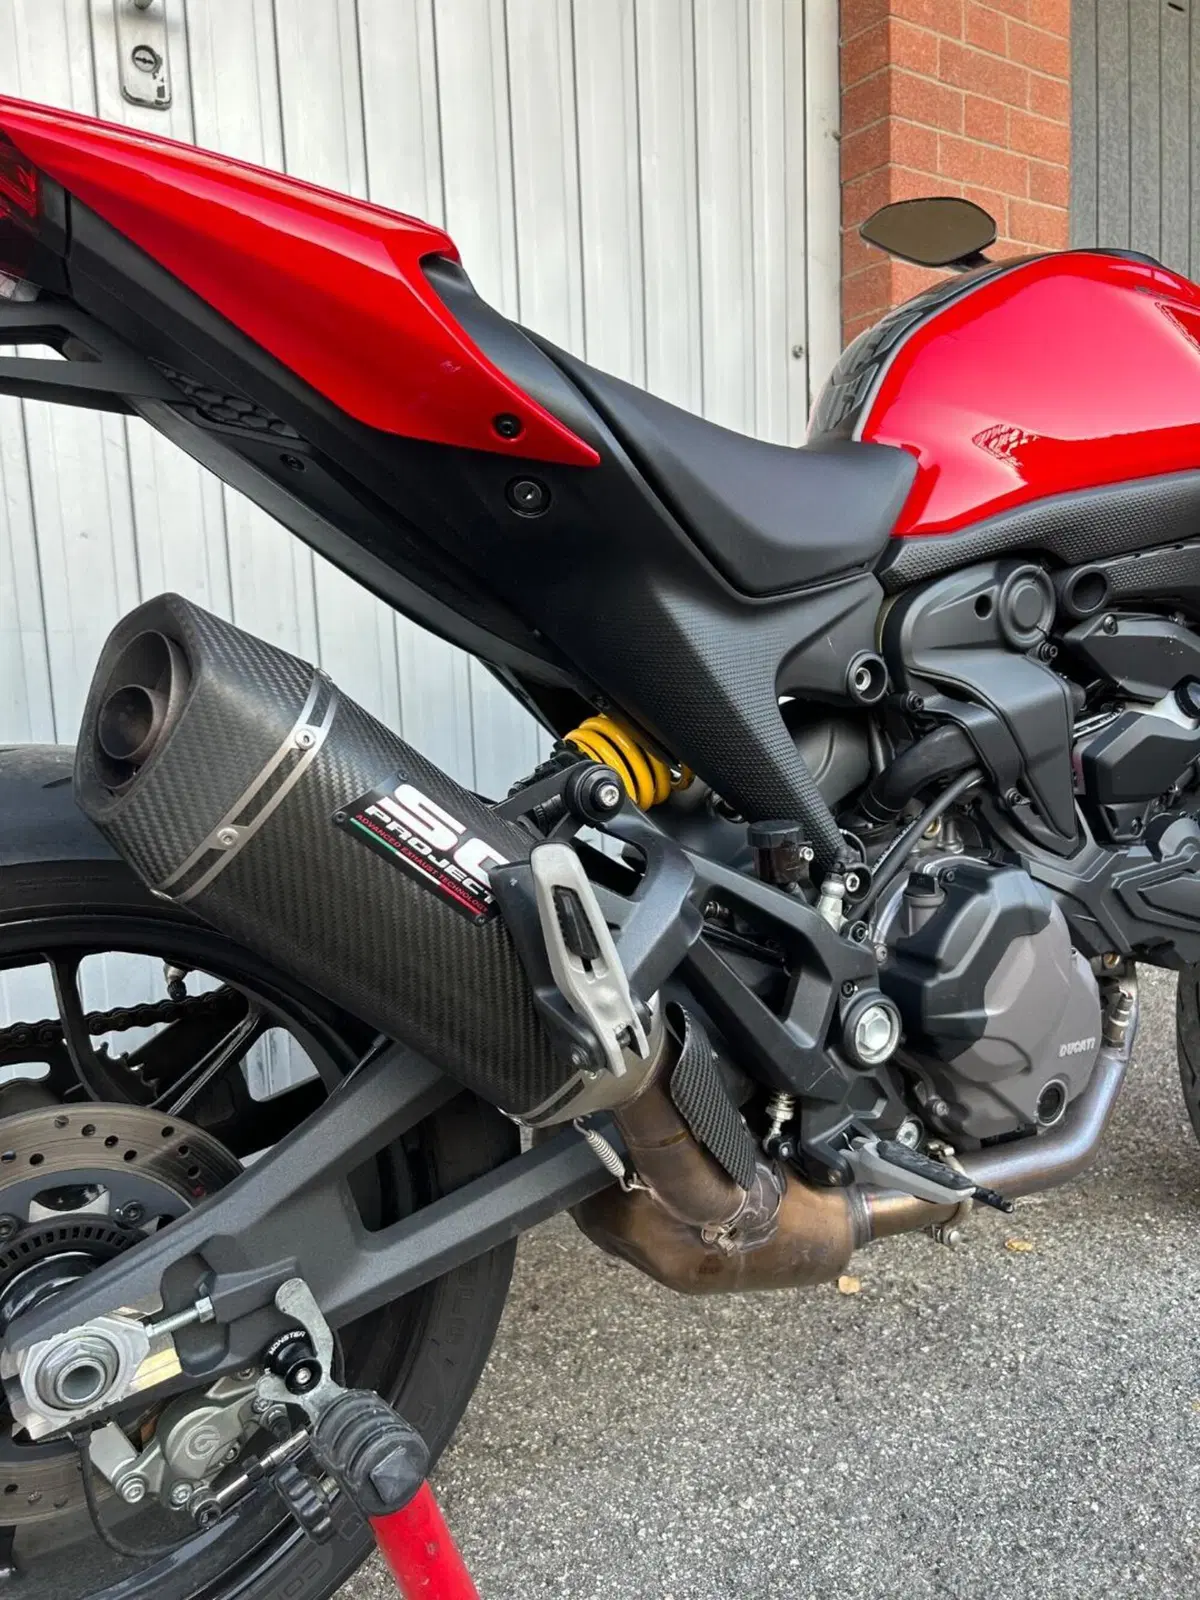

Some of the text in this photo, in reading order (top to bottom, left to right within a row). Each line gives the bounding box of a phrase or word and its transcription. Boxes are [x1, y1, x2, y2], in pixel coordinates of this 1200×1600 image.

[355, 814, 488, 913] ADVANCED EXHAUST TECHNOLOGY
[364, 804, 496, 904] PROJECT
[1059, 1036, 1096, 1058] DUCATI
[268, 1331, 306, 1356] MONSTER
